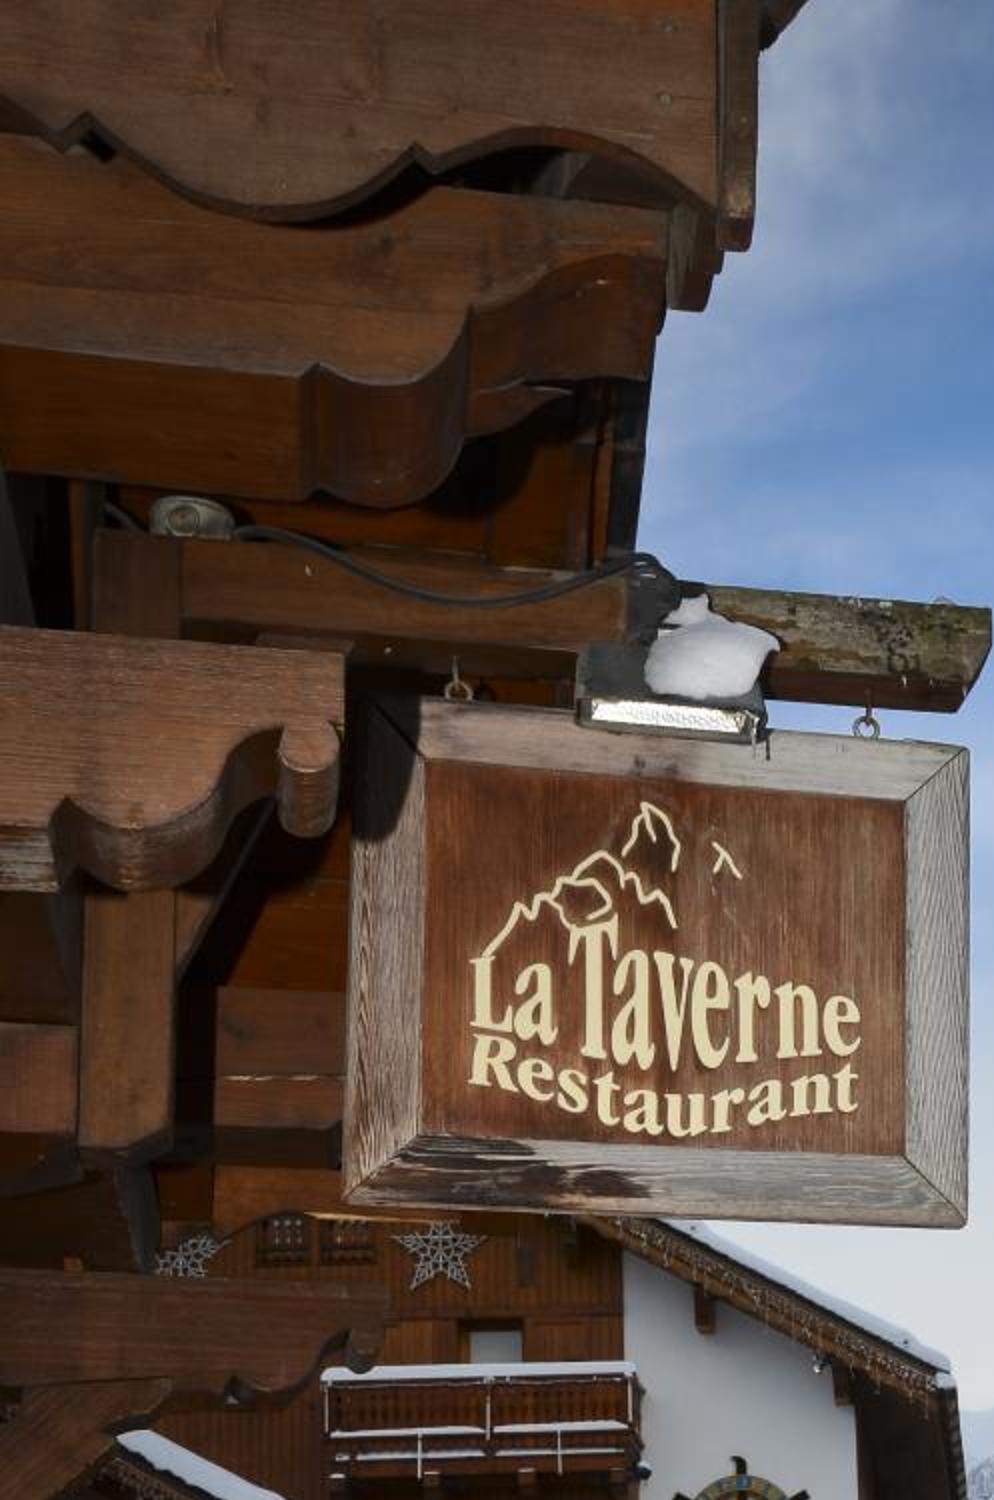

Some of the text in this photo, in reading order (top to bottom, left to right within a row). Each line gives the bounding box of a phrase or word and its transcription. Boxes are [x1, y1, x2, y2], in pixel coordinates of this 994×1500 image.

[469, 914, 862, 1072] La Taverne
[467, 1033, 860, 1138] Restaurant
